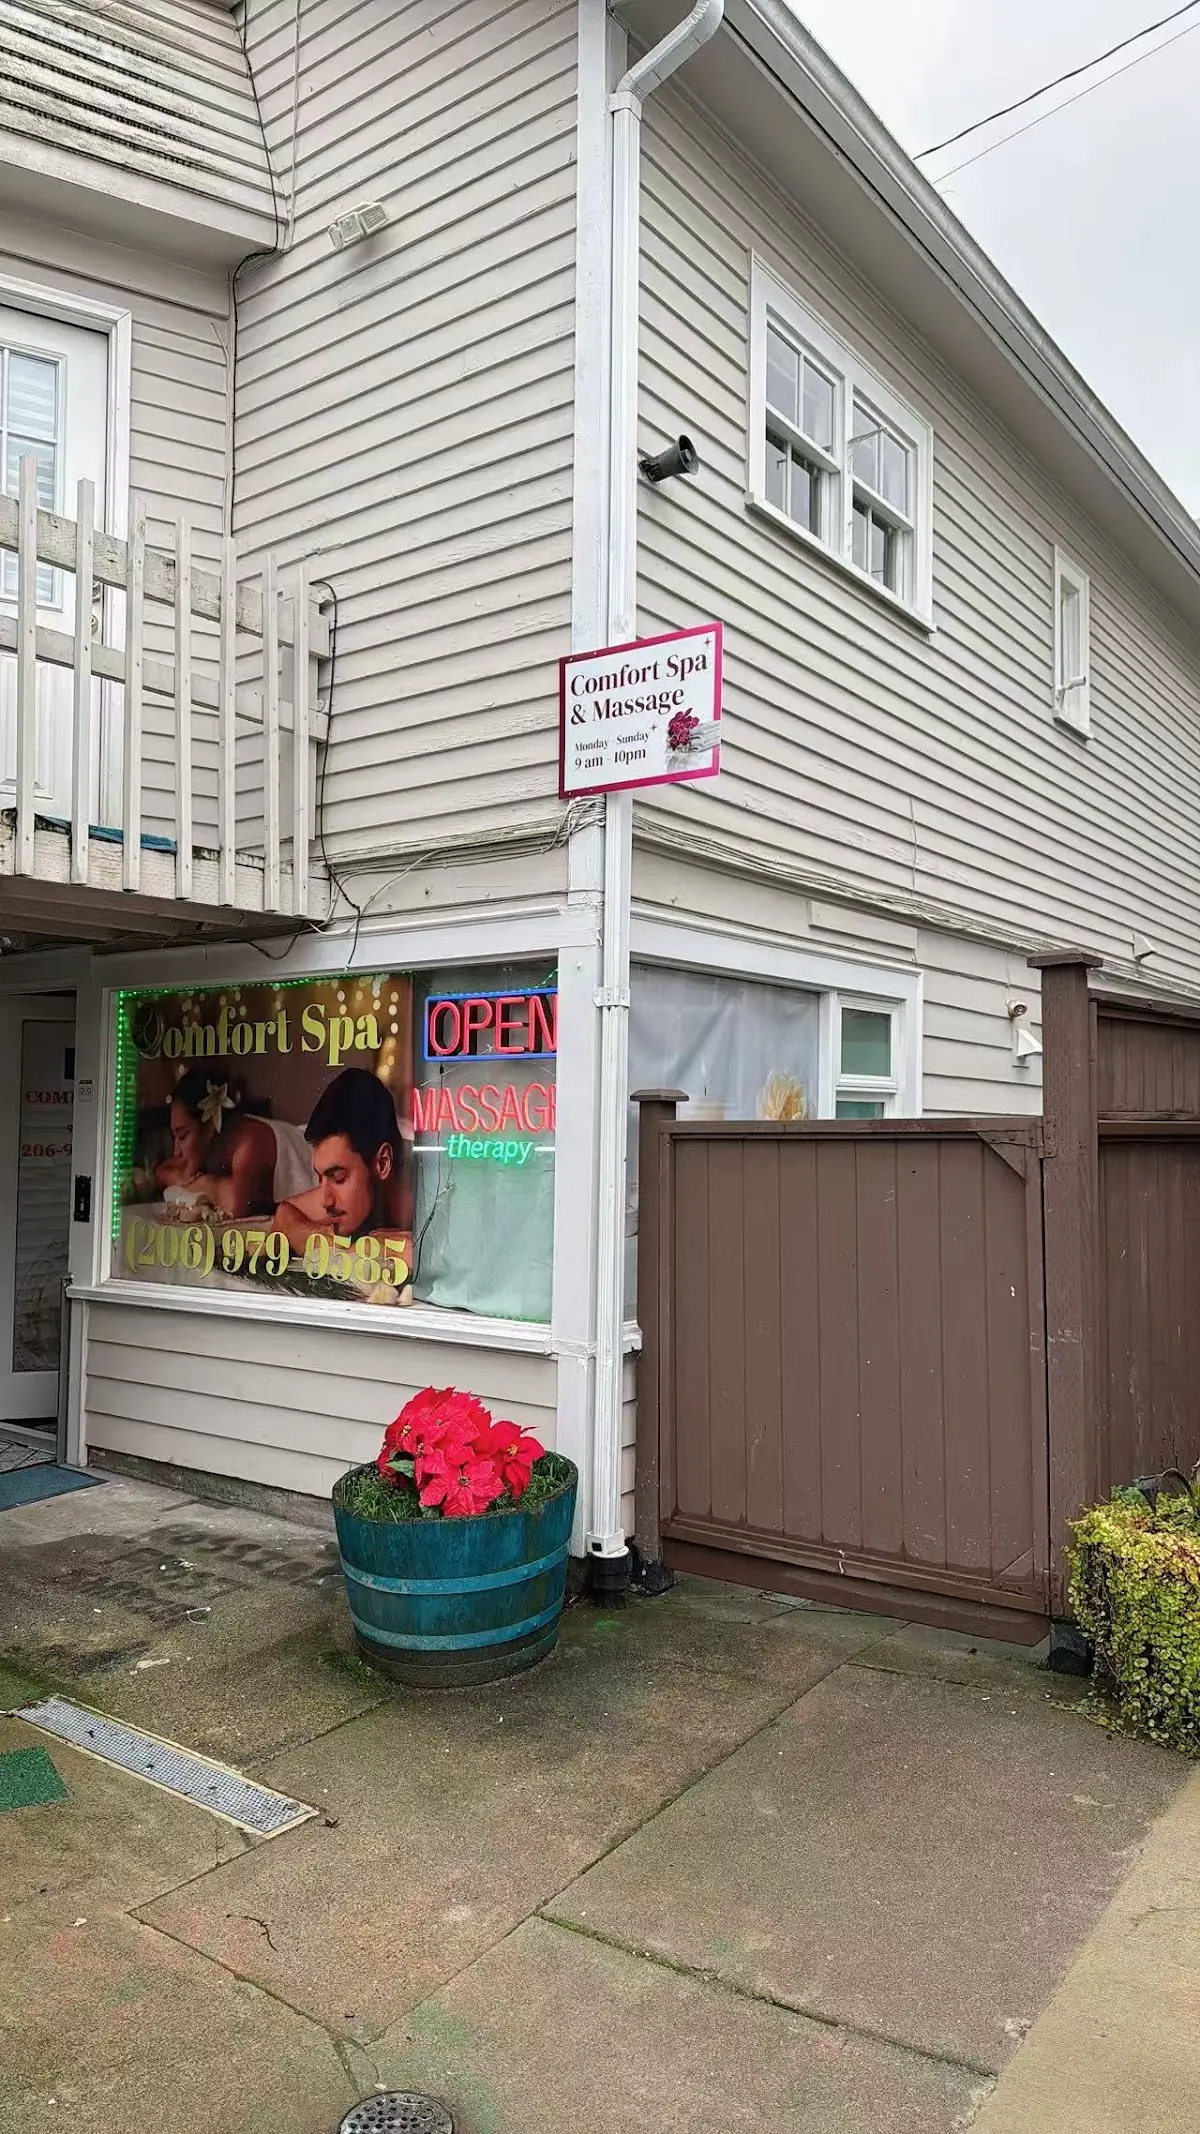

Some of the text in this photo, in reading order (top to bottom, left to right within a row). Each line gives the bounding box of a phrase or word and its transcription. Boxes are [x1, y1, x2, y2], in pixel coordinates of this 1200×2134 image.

[571, 653, 707, 696] Comfort Spa
[571, 688, 684, 725] & Massage
[574, 757, 582, 770] 9
[585, 756, 603, 768] am
[614, 748, 646, 765] 10pm
[575, 738, 608, 751] Monday
[617, 731, 649, 745] Sunday
[301, 1003, 382, 1066] Spa
[430, 995, 558, 1055] OPEN
[447, 1134, 533, 1164] therapy
